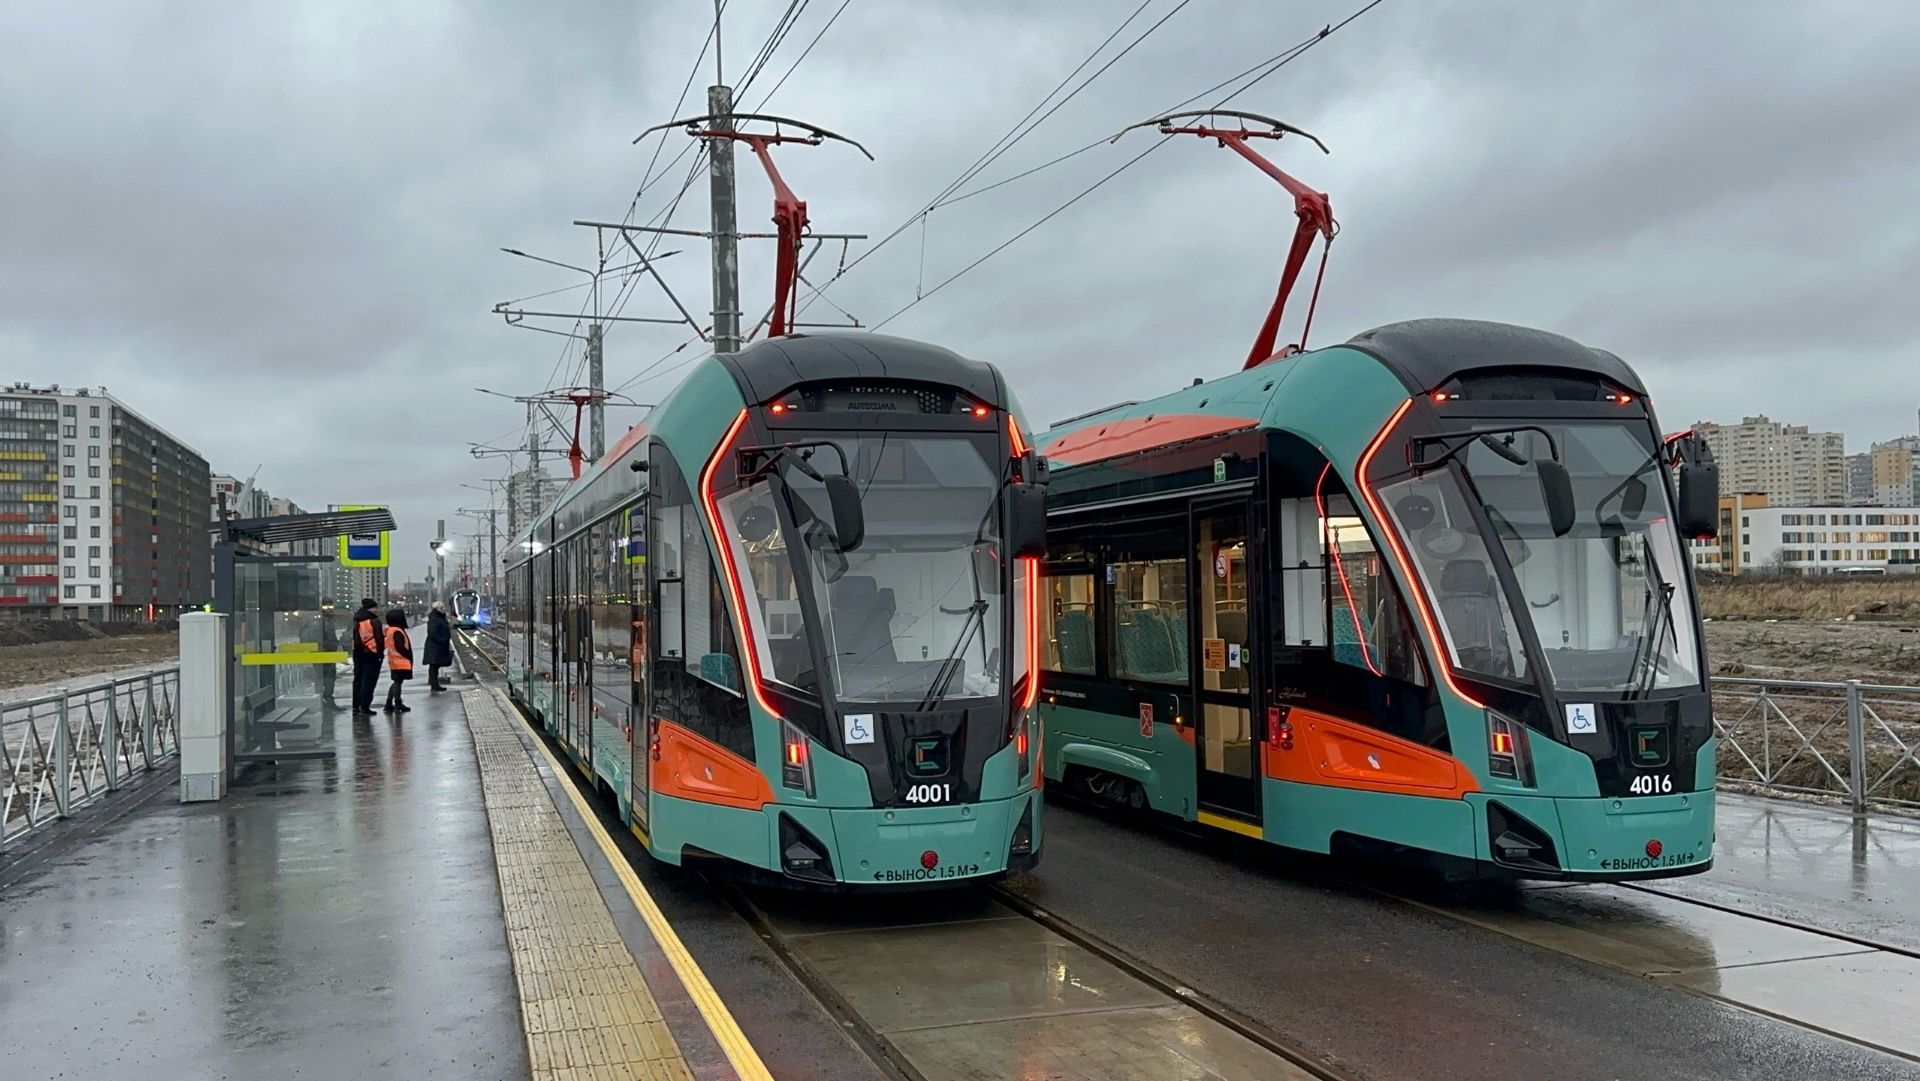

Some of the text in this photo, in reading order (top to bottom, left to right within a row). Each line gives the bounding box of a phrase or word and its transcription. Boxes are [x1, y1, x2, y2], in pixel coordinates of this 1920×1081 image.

[905, 783, 950, 803] 4001
[1629, 774, 1672, 794] 4016
[1613, 853, 1686, 870] ВЫНОС 1.5 М
[886, 864, 969, 881] ВЫНОС 1.5 М
